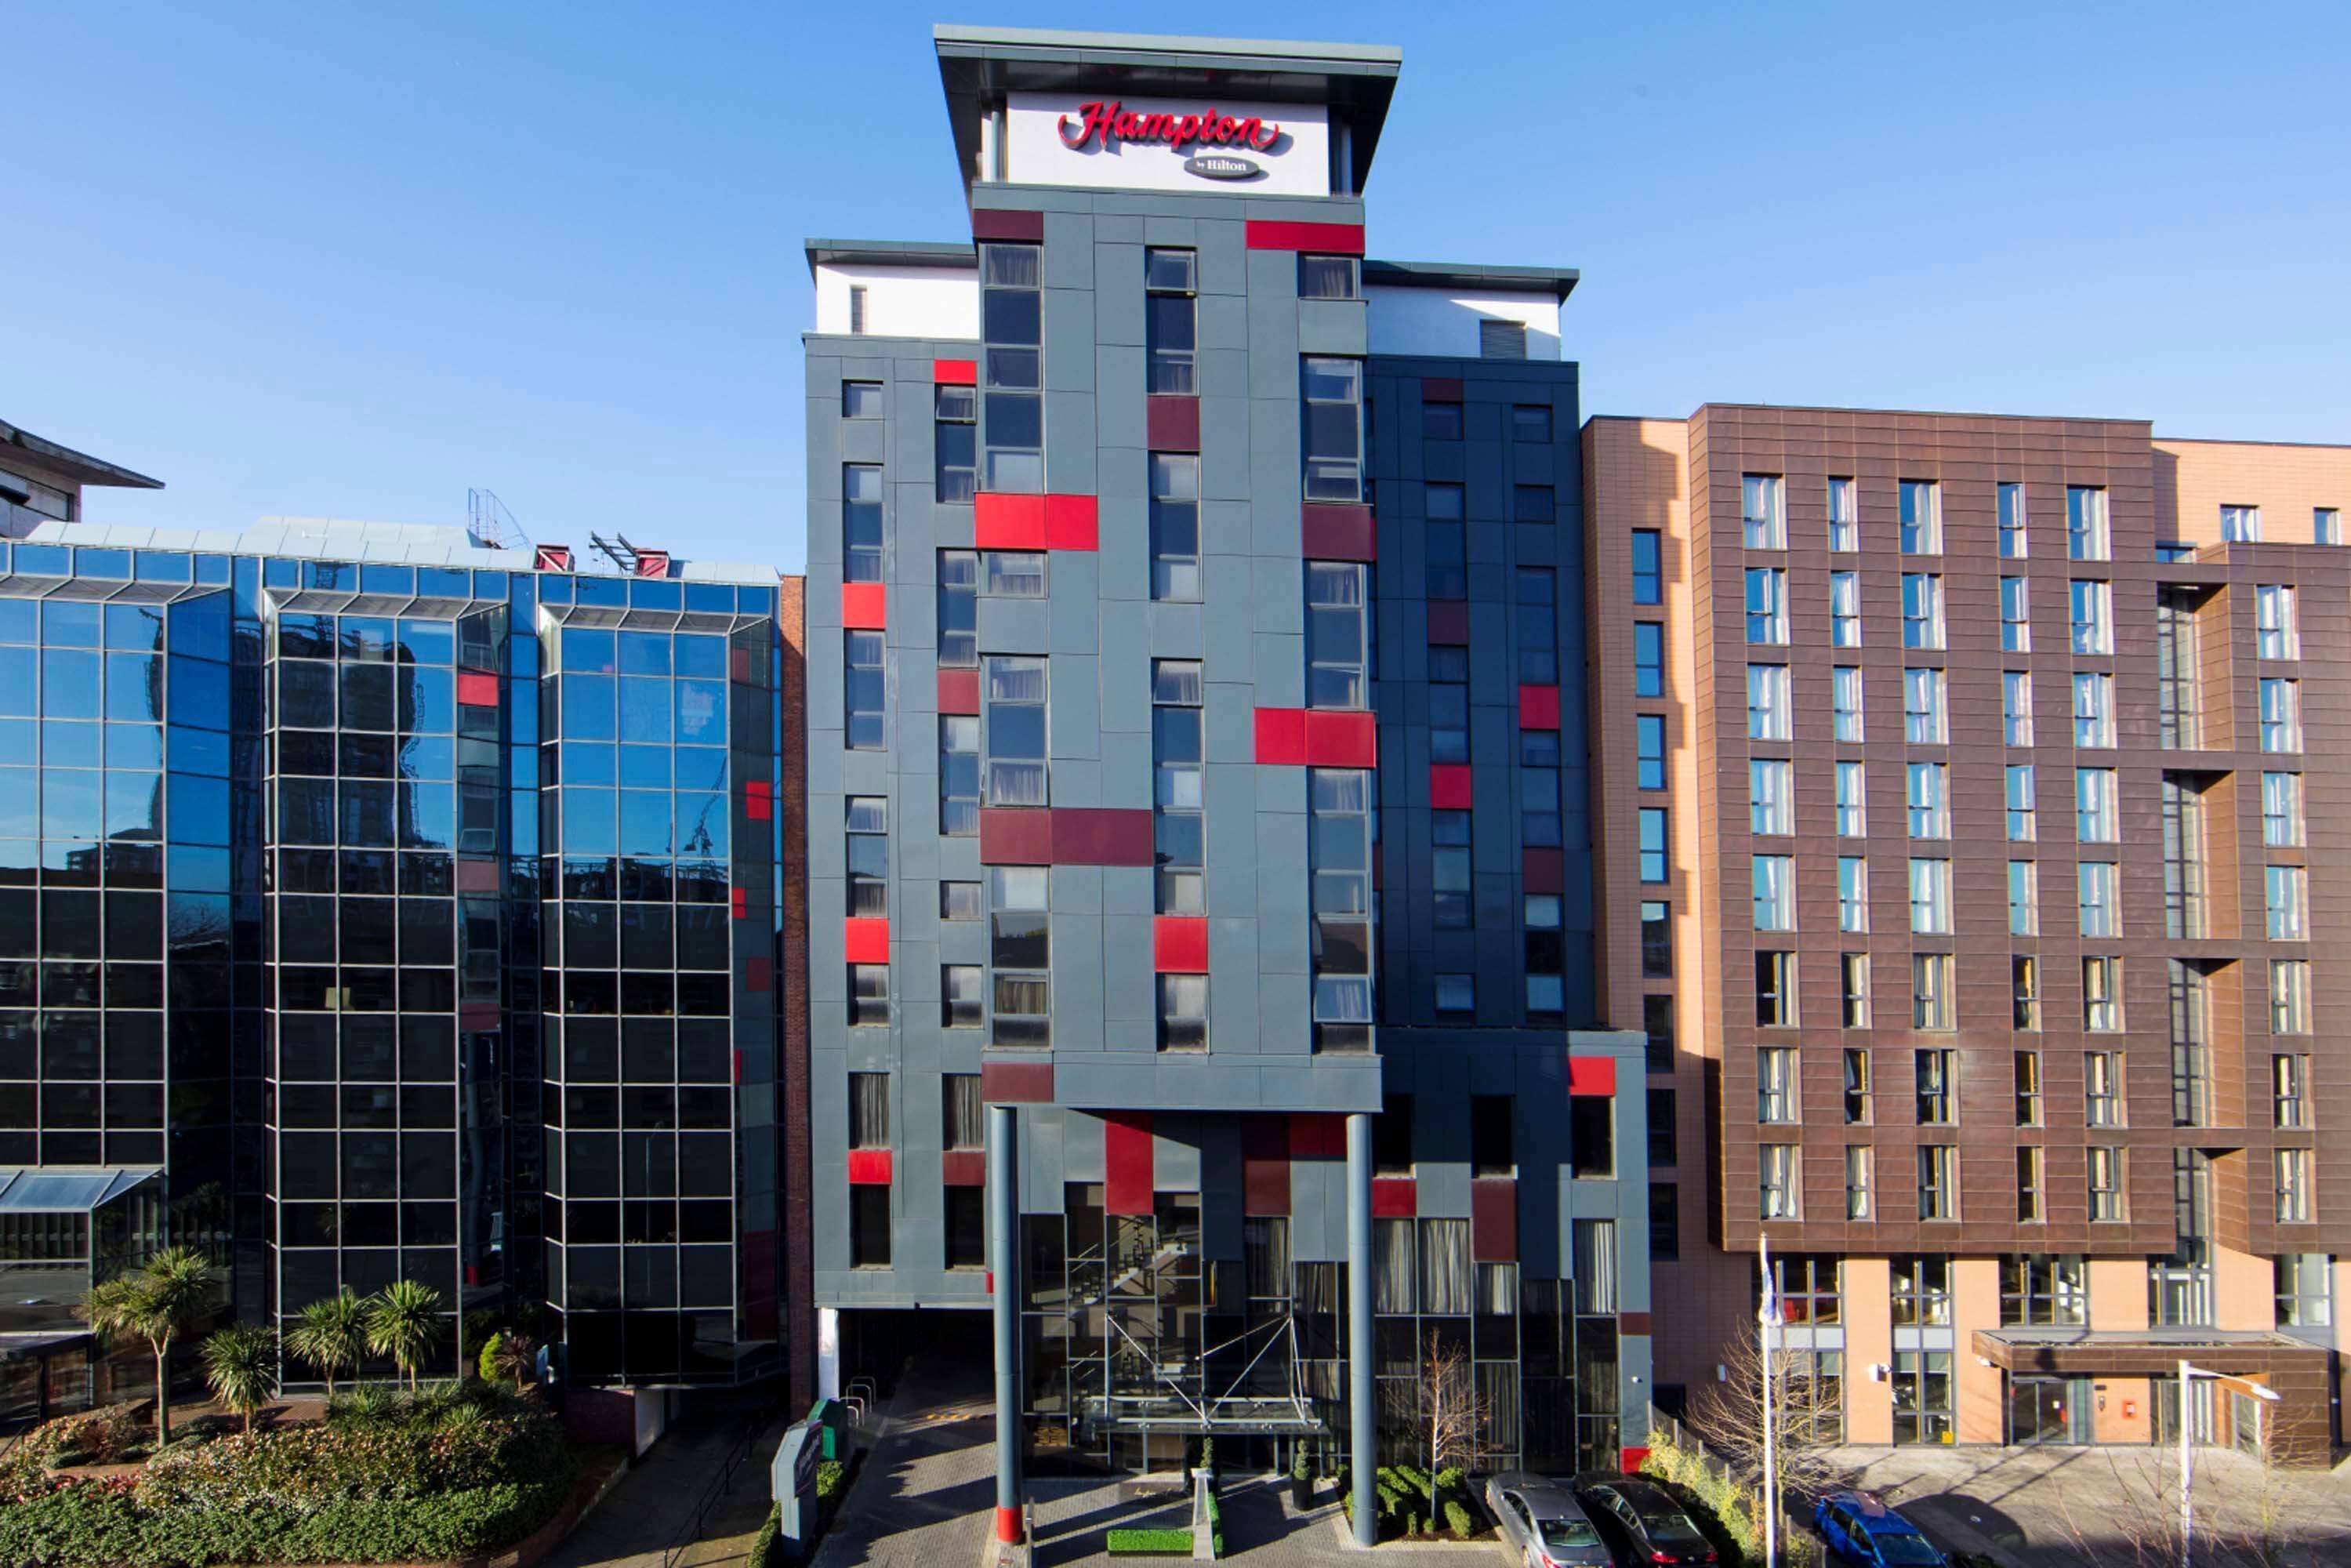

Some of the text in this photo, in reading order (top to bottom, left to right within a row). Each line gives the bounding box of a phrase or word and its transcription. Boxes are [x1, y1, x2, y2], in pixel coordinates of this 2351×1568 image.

[1058, 101, 1279, 151] Hampton
[1196, 159, 1246, 171] by Hilton
